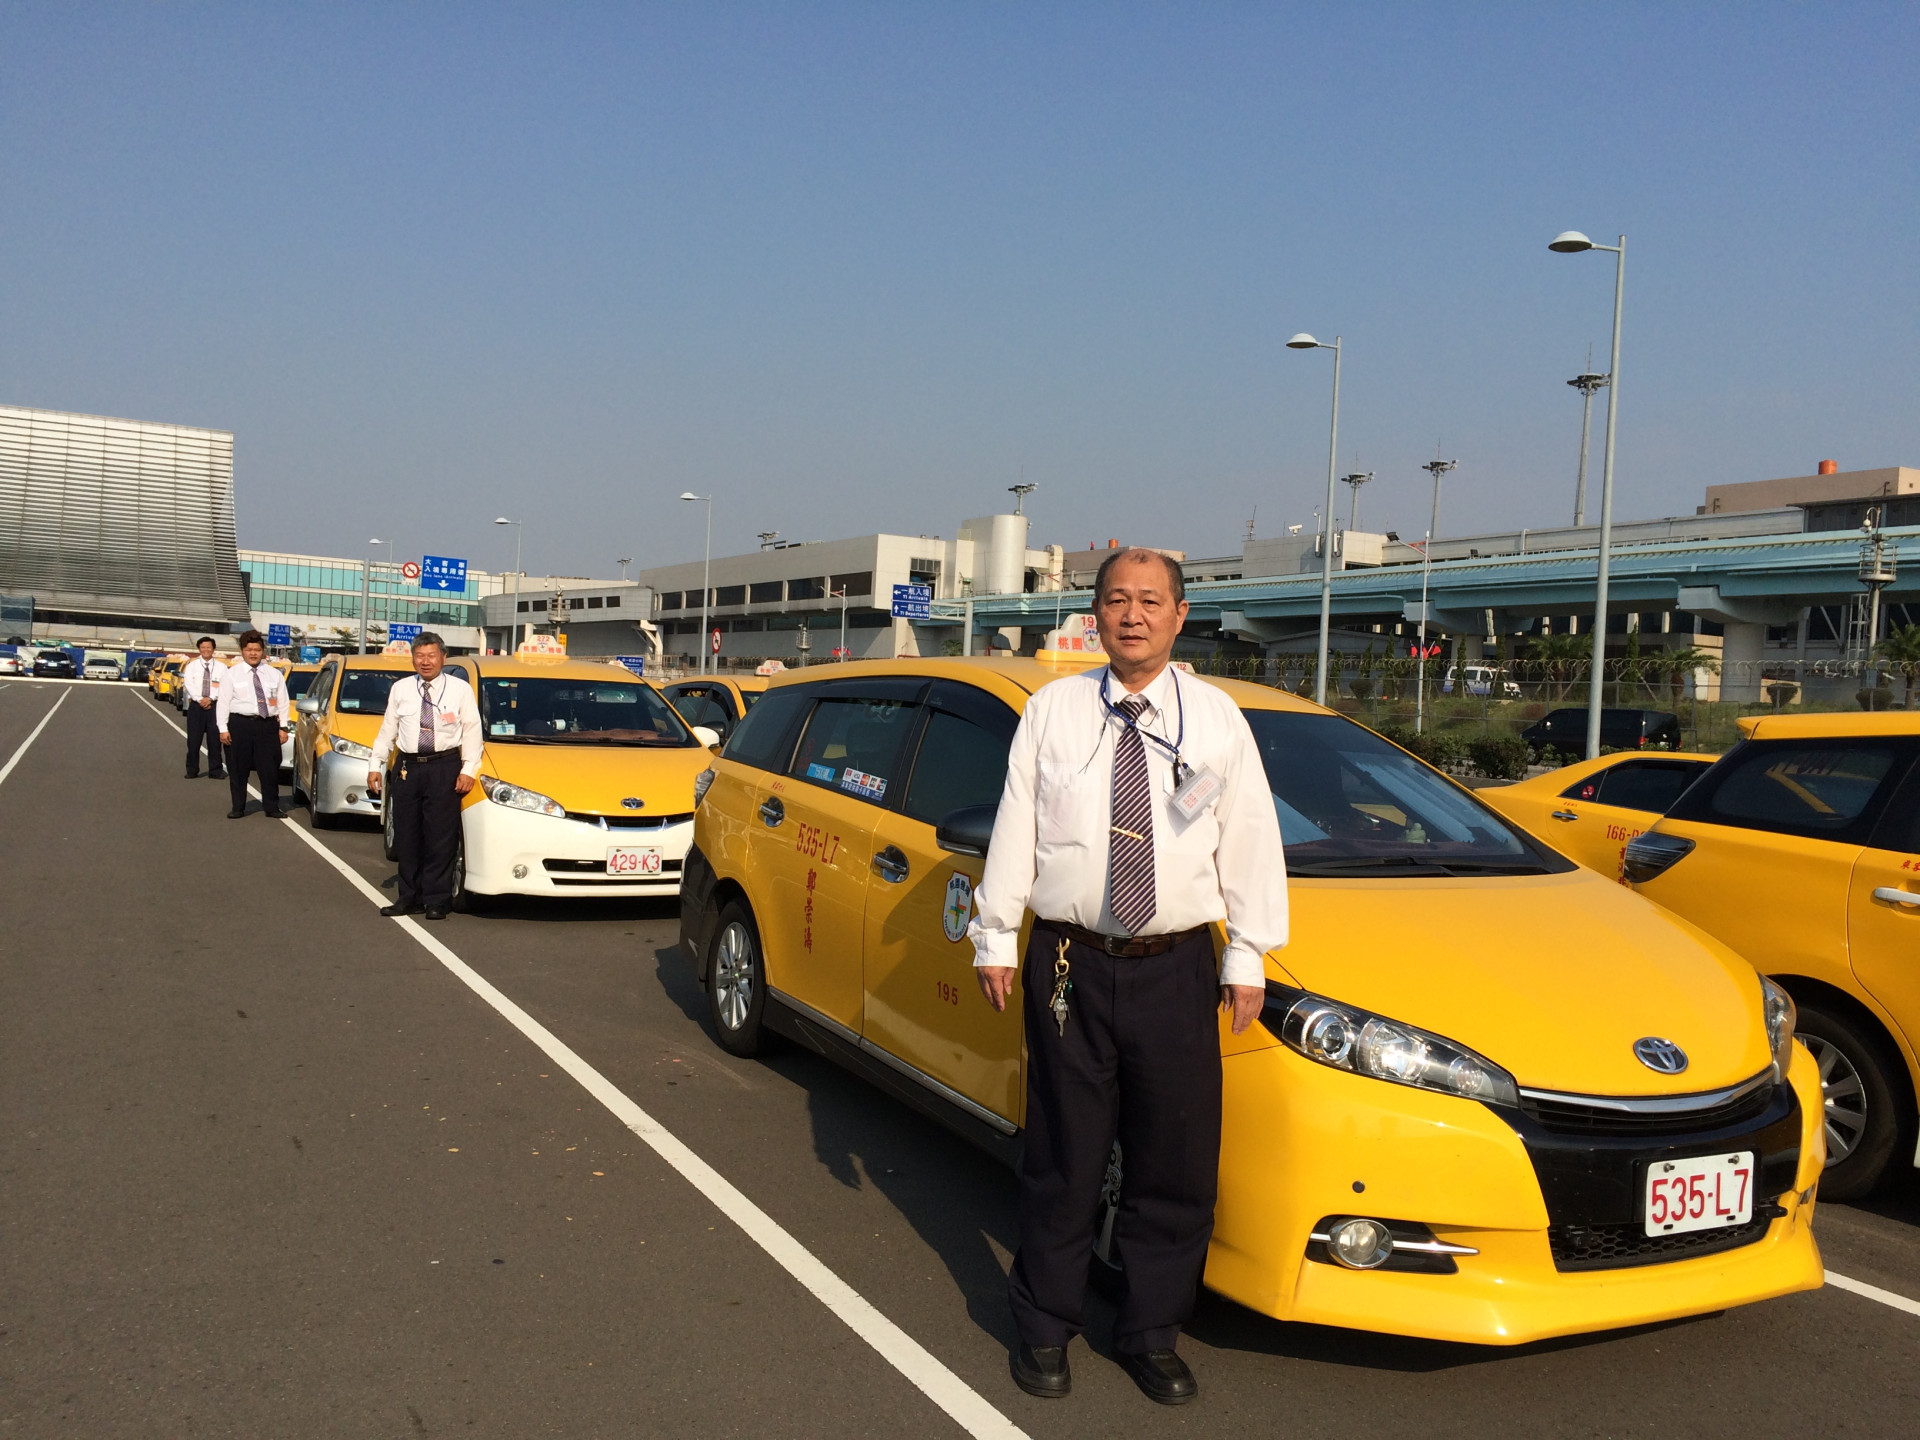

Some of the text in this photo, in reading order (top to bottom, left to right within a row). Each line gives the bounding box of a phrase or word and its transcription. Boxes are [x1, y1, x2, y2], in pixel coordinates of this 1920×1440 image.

[900, 603, 929, 612] 一航出境
[1081, 616, 1095, 627] 19
[389, 626, 421, 635] 一航入境
[1058, 636, 1083, 650] 桃園
[796, 822, 840, 864] 535-L7
[610, 853, 660, 871] 429-K3
[936, 981, 958, 1006] 195
[1651, 1168, 1749, 1224] 535-L7
